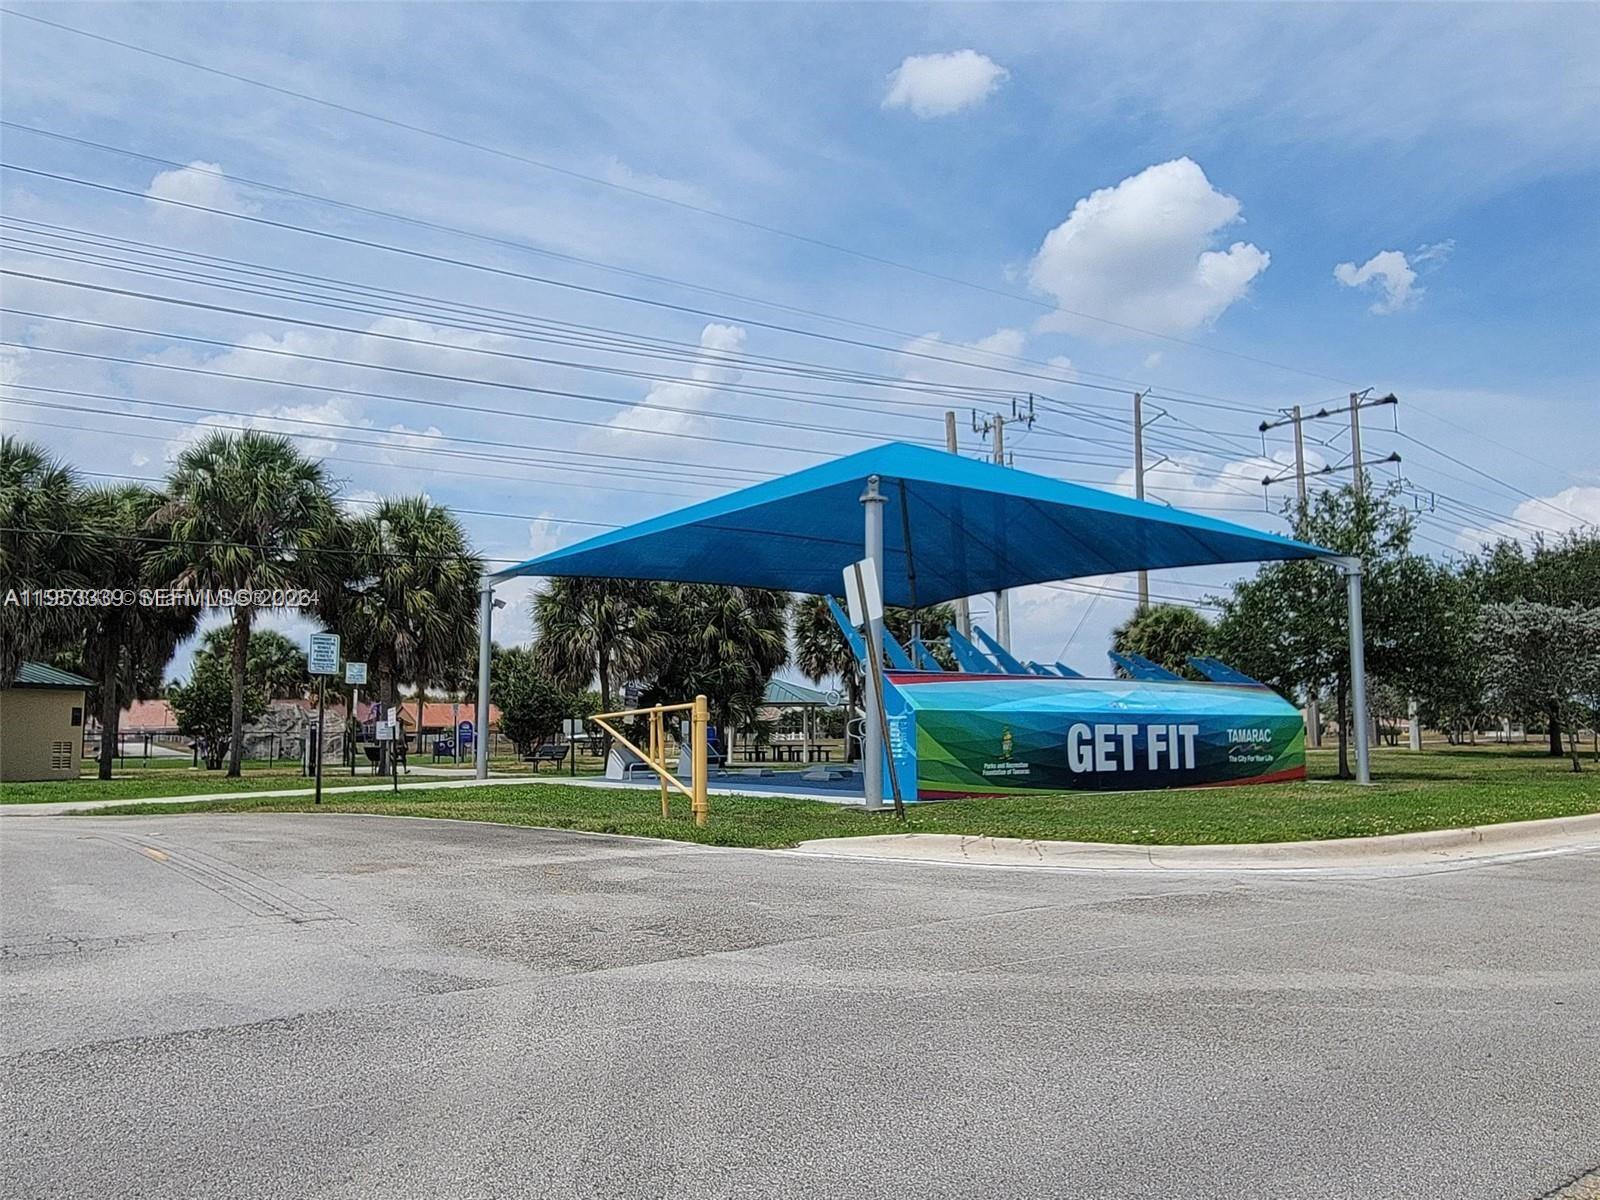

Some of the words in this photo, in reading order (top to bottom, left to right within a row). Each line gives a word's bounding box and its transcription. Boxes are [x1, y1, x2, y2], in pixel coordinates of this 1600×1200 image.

[1067, 722, 1139, 774] GET
[1147, 724, 1199, 770] FIT
[1227, 728, 1272, 743] TAMARAC
